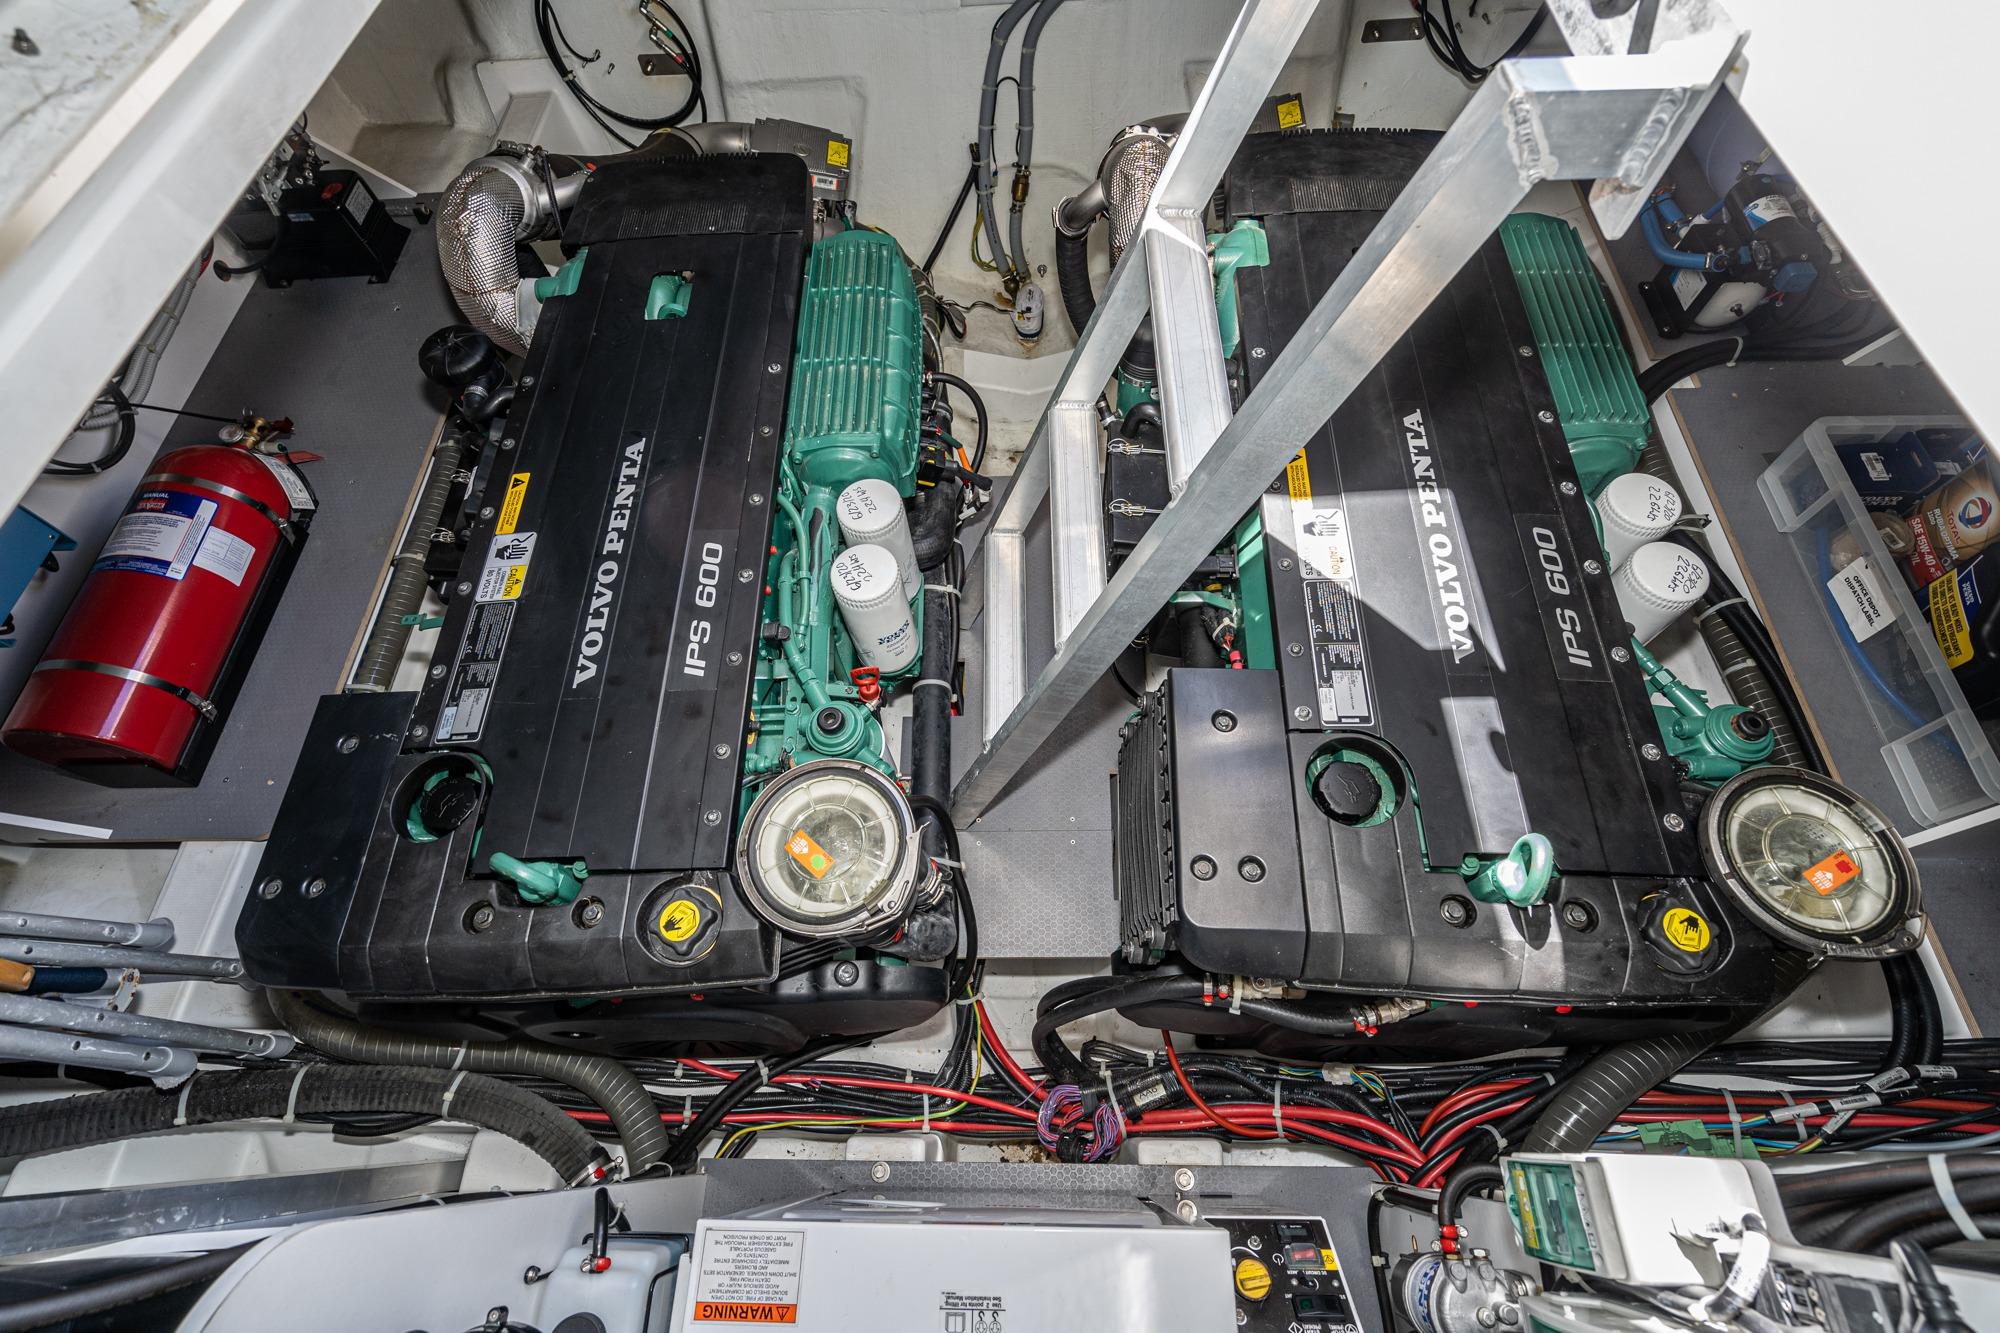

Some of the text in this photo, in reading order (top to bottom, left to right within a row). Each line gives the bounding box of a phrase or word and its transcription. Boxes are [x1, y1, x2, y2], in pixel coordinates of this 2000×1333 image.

[1403, 408, 1475, 664] VOLVO PENTA
[1911, 517, 1936, 566] SAE 15W-40
[1933, 507, 1946, 531] RUBIA
[1940, 531, 1959, 561] OPTIMA
[1946, 510, 1963, 545] TOTAL
[504, 568, 518, 597] CAUTION
[572, 438, 646, 688] VOLVO PENTA
[1329, 545, 1341, 575] CAUTION
[480, 577, 492, 599] VOLTS
[684, 542, 723, 677] IPS 600
[1532, 526, 1593, 668] IPS 600
[1844, 576, 1875, 627] DISPATCH LABEL
[1852, 575, 1881, 618] OFFICE DEPOT
[702, 1305, 773, 1320] WARNING
